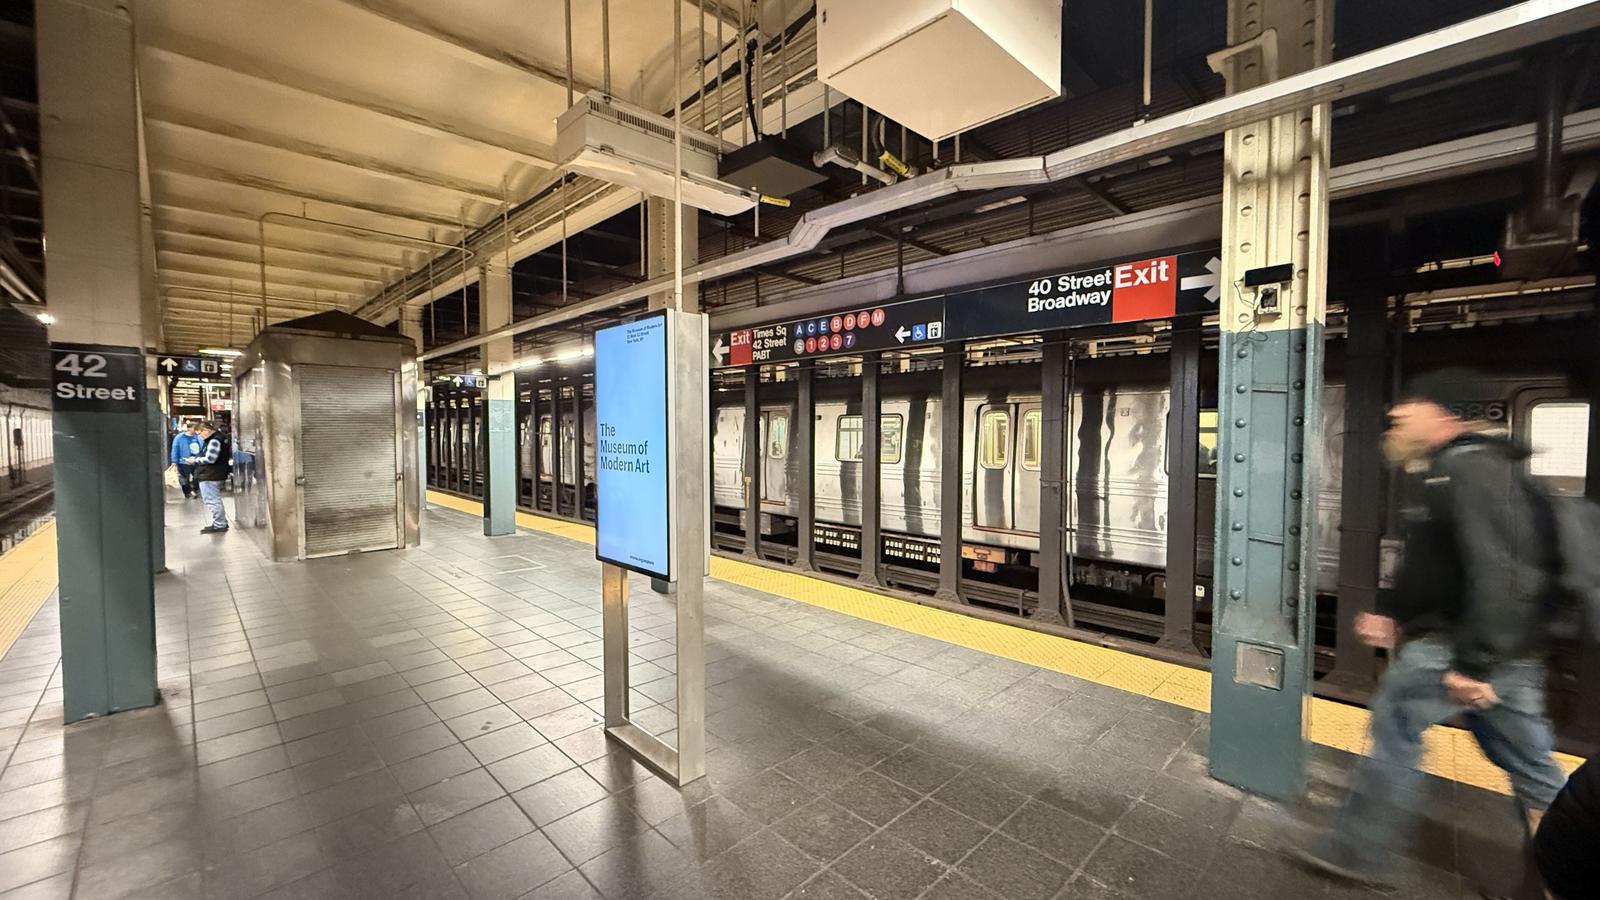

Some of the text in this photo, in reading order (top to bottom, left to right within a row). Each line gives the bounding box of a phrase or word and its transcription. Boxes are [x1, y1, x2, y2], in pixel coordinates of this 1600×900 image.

[1028, 269, 1112, 296] 40 Street
[1115, 260, 1169, 288] Exit
[1028, 289, 1112, 313] Broadway
[731, 330, 750, 346] Exit
[753, 325, 787, 339] Times Sq
[752, 337, 787, 350] 42 Street
[752, 349, 771, 361] PABT
[55, 353, 108, 378] 42
[56, 382, 136, 400] Street
[600, 423, 616, 437] The
[600, 439, 649, 456] Museum of
[600, 456, 650, 474] Modern Art
